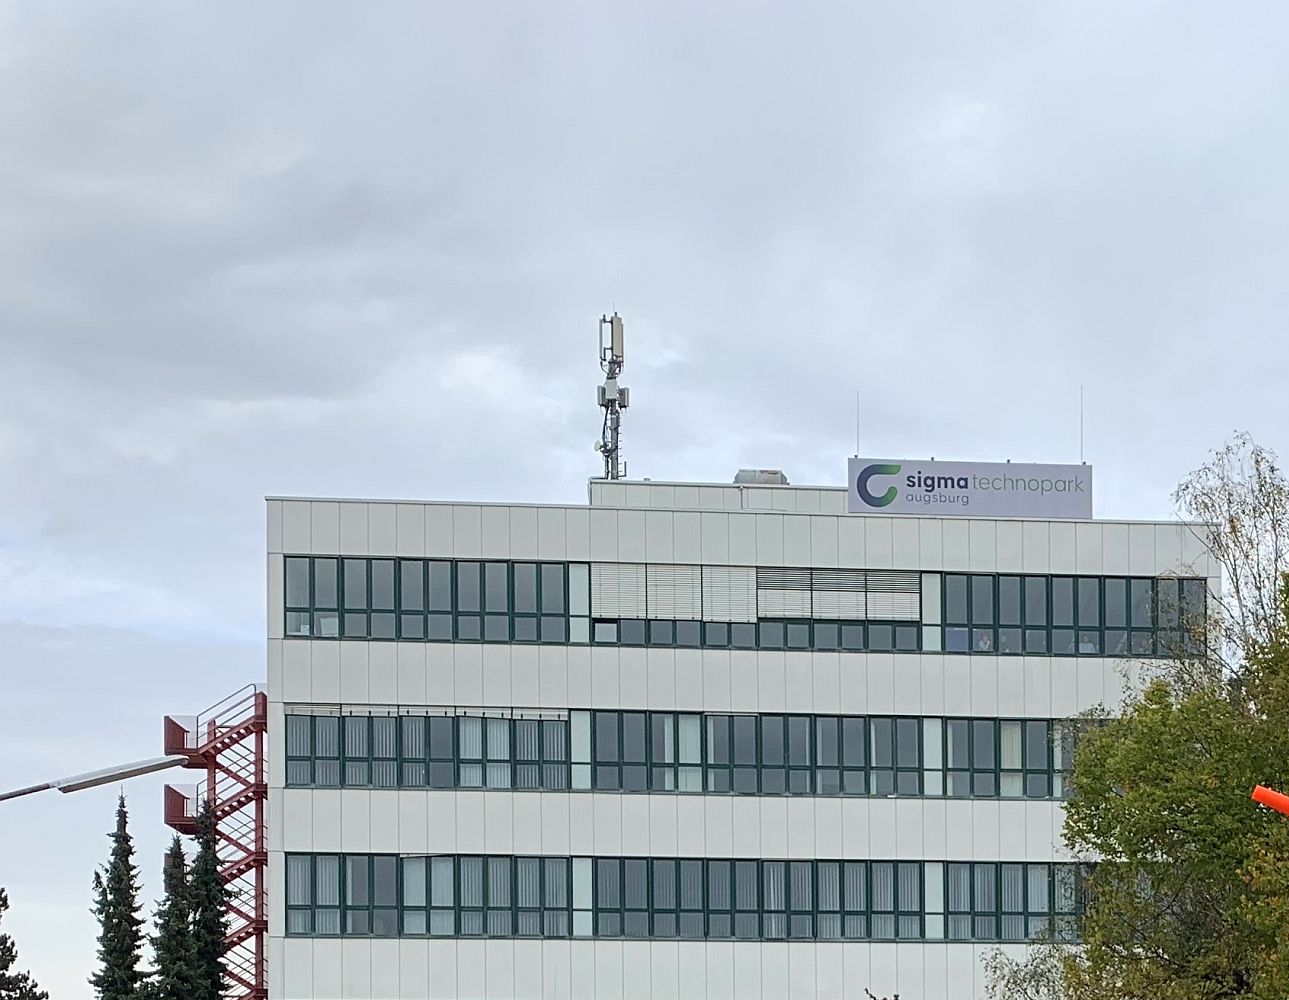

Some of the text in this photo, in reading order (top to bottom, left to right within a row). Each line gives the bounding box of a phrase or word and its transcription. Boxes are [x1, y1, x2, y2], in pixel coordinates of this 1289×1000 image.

[906, 471, 1084, 496] sigma technopark
[906, 492, 969, 506] augsburg
